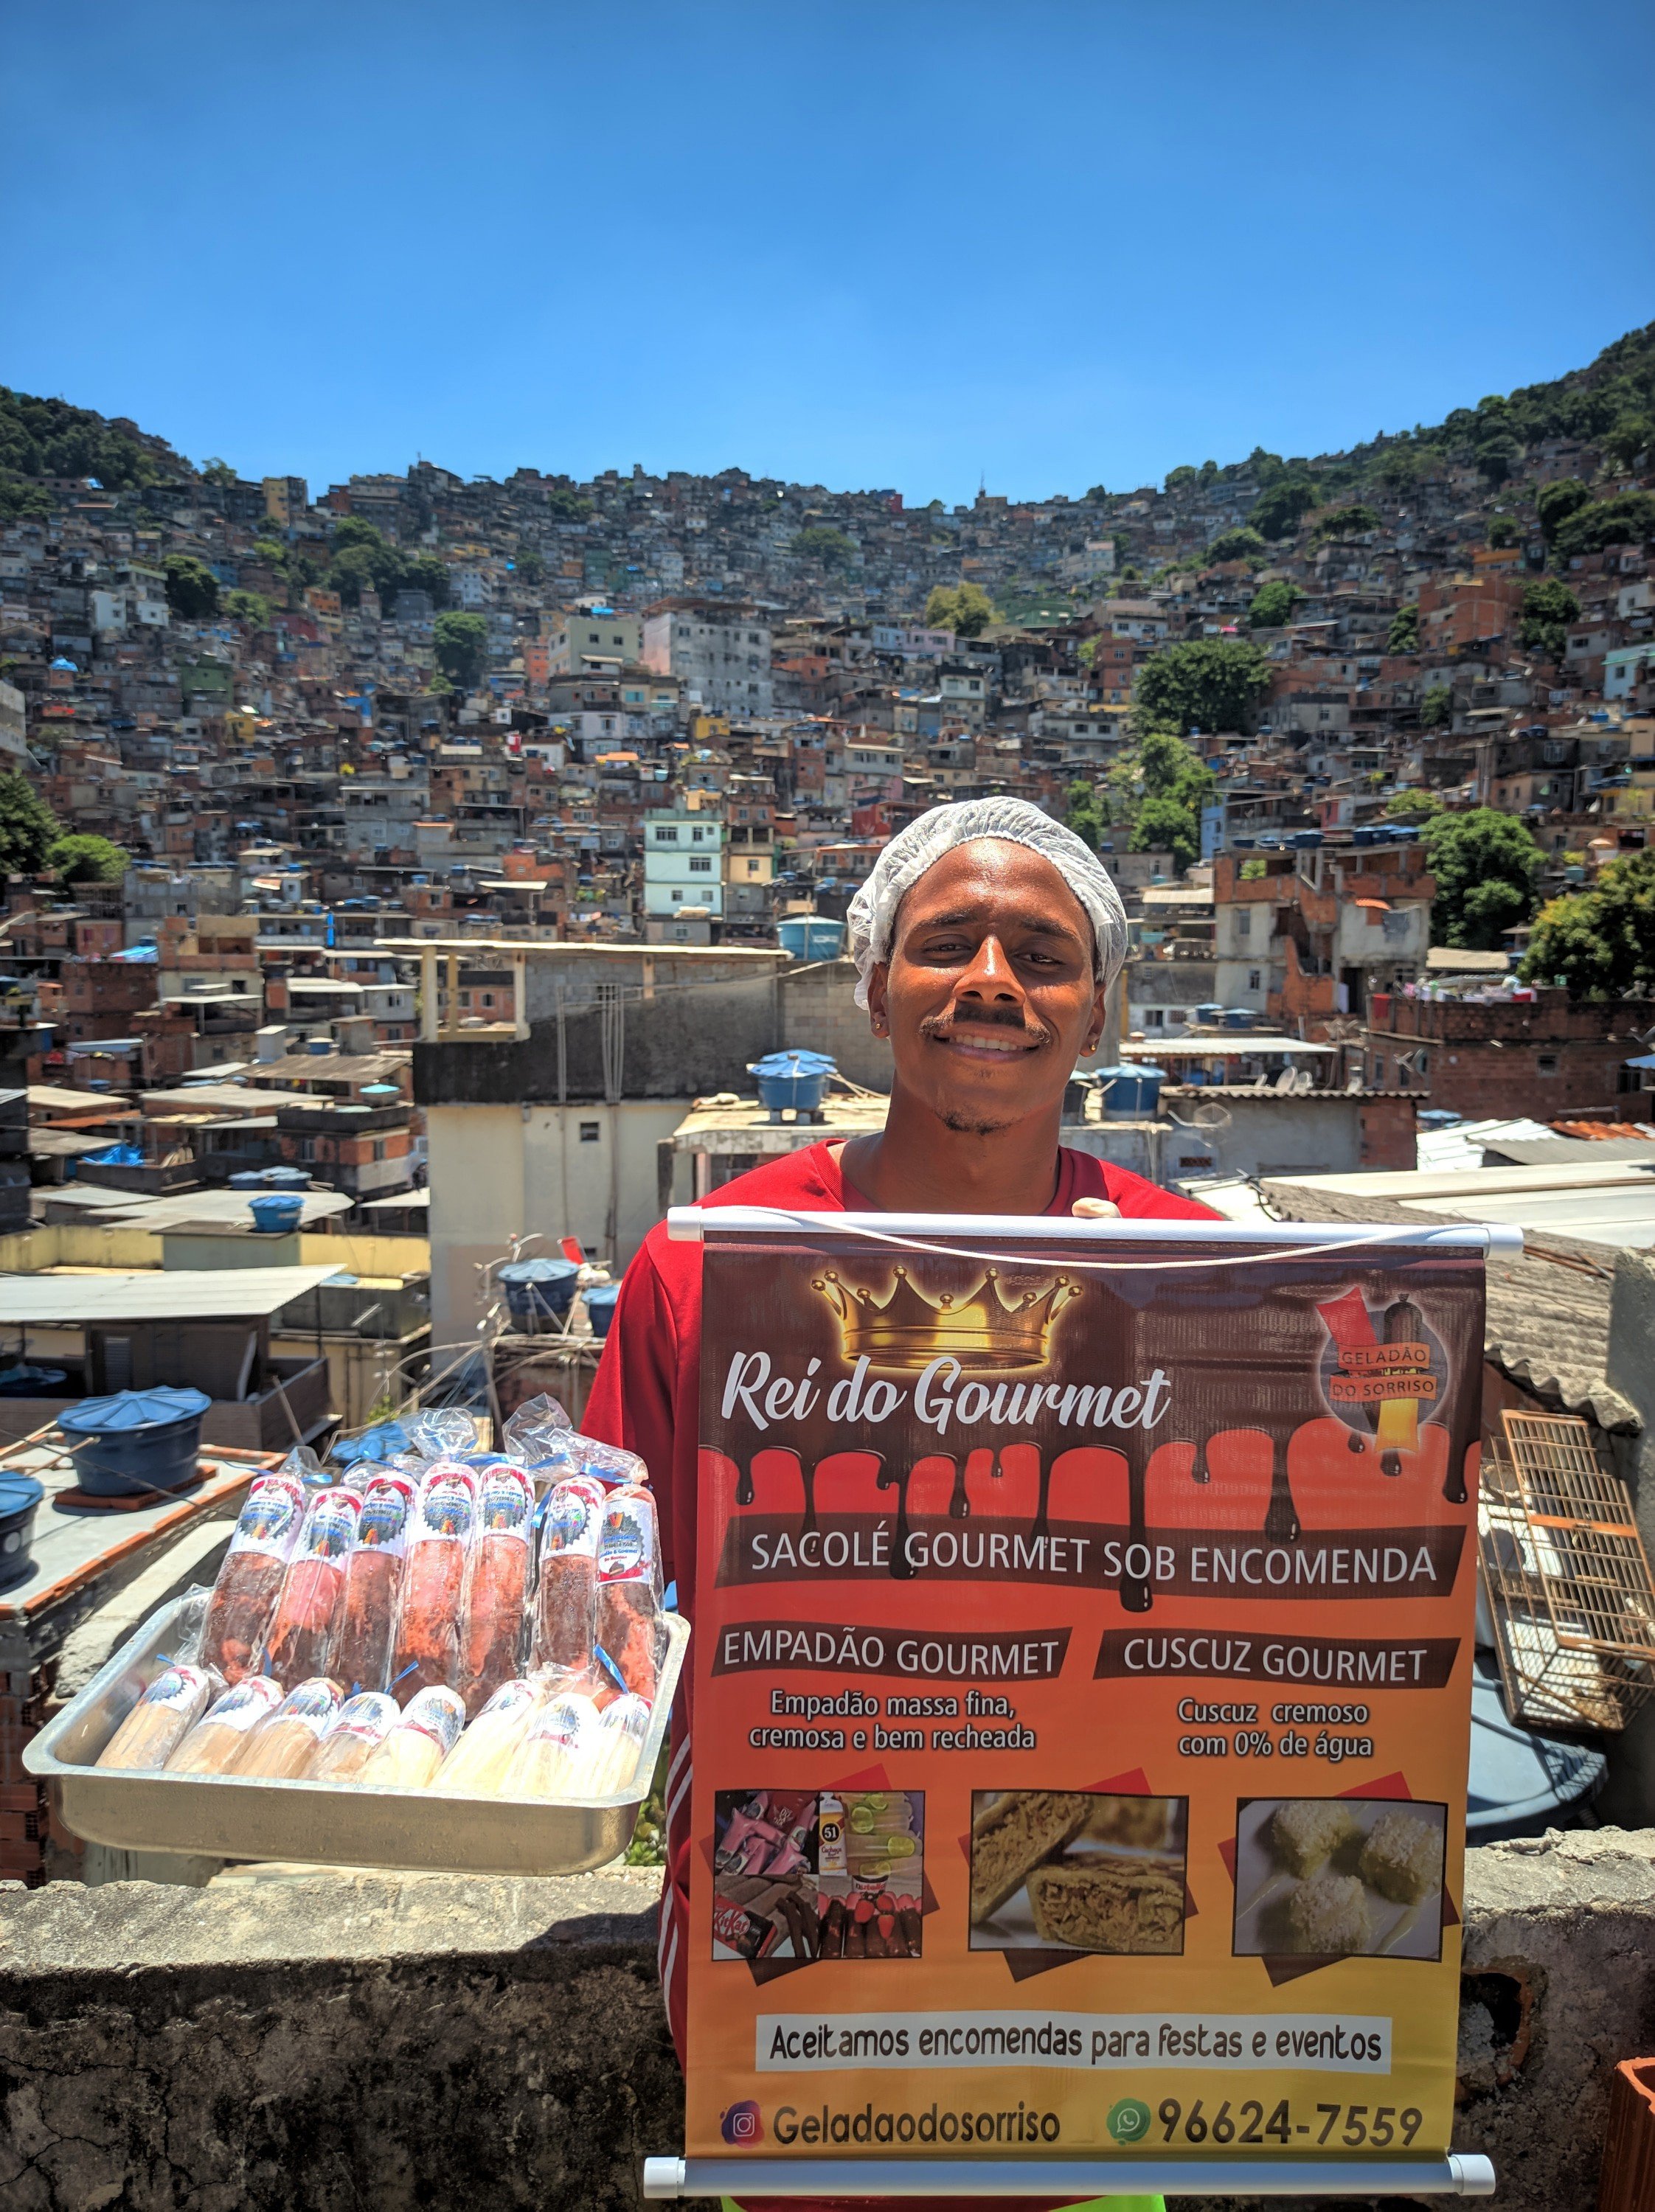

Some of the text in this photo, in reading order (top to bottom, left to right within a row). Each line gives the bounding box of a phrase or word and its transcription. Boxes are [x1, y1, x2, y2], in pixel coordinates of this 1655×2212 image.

[1342, 1347, 1426, 1365] GELADÃO
[721, 1351, 1171, 1435] Rei do Gourmet
[1333, 1380, 1434, 1397] DO SORRISO
[751, 1520, 1437, 1585] SACOLÉ GOURMET SOB ENCOMENDA
[724, 1627, 1059, 1676] EMPADÃO GOURMET
[1124, 1637, 1427, 1682] CUSCUZ GOURMET
[771, 1689, 1015, 1720] Empadão massa fina,
[1178, 1698, 1369, 1724] Cuscuz cremoso
[749, 1723, 1036, 1750] cremosa e bem recheada
[1179, 1731, 1373, 1761] com 0% de água
[824, 1826, 836, 1839] 51
[769, 2021, 1382, 2065] Aceitamos encomendas para festas e eventos
[773, 2101, 1061, 2145] Geladaodosorriso
[1158, 2098, 1423, 2147] 96624-7559
